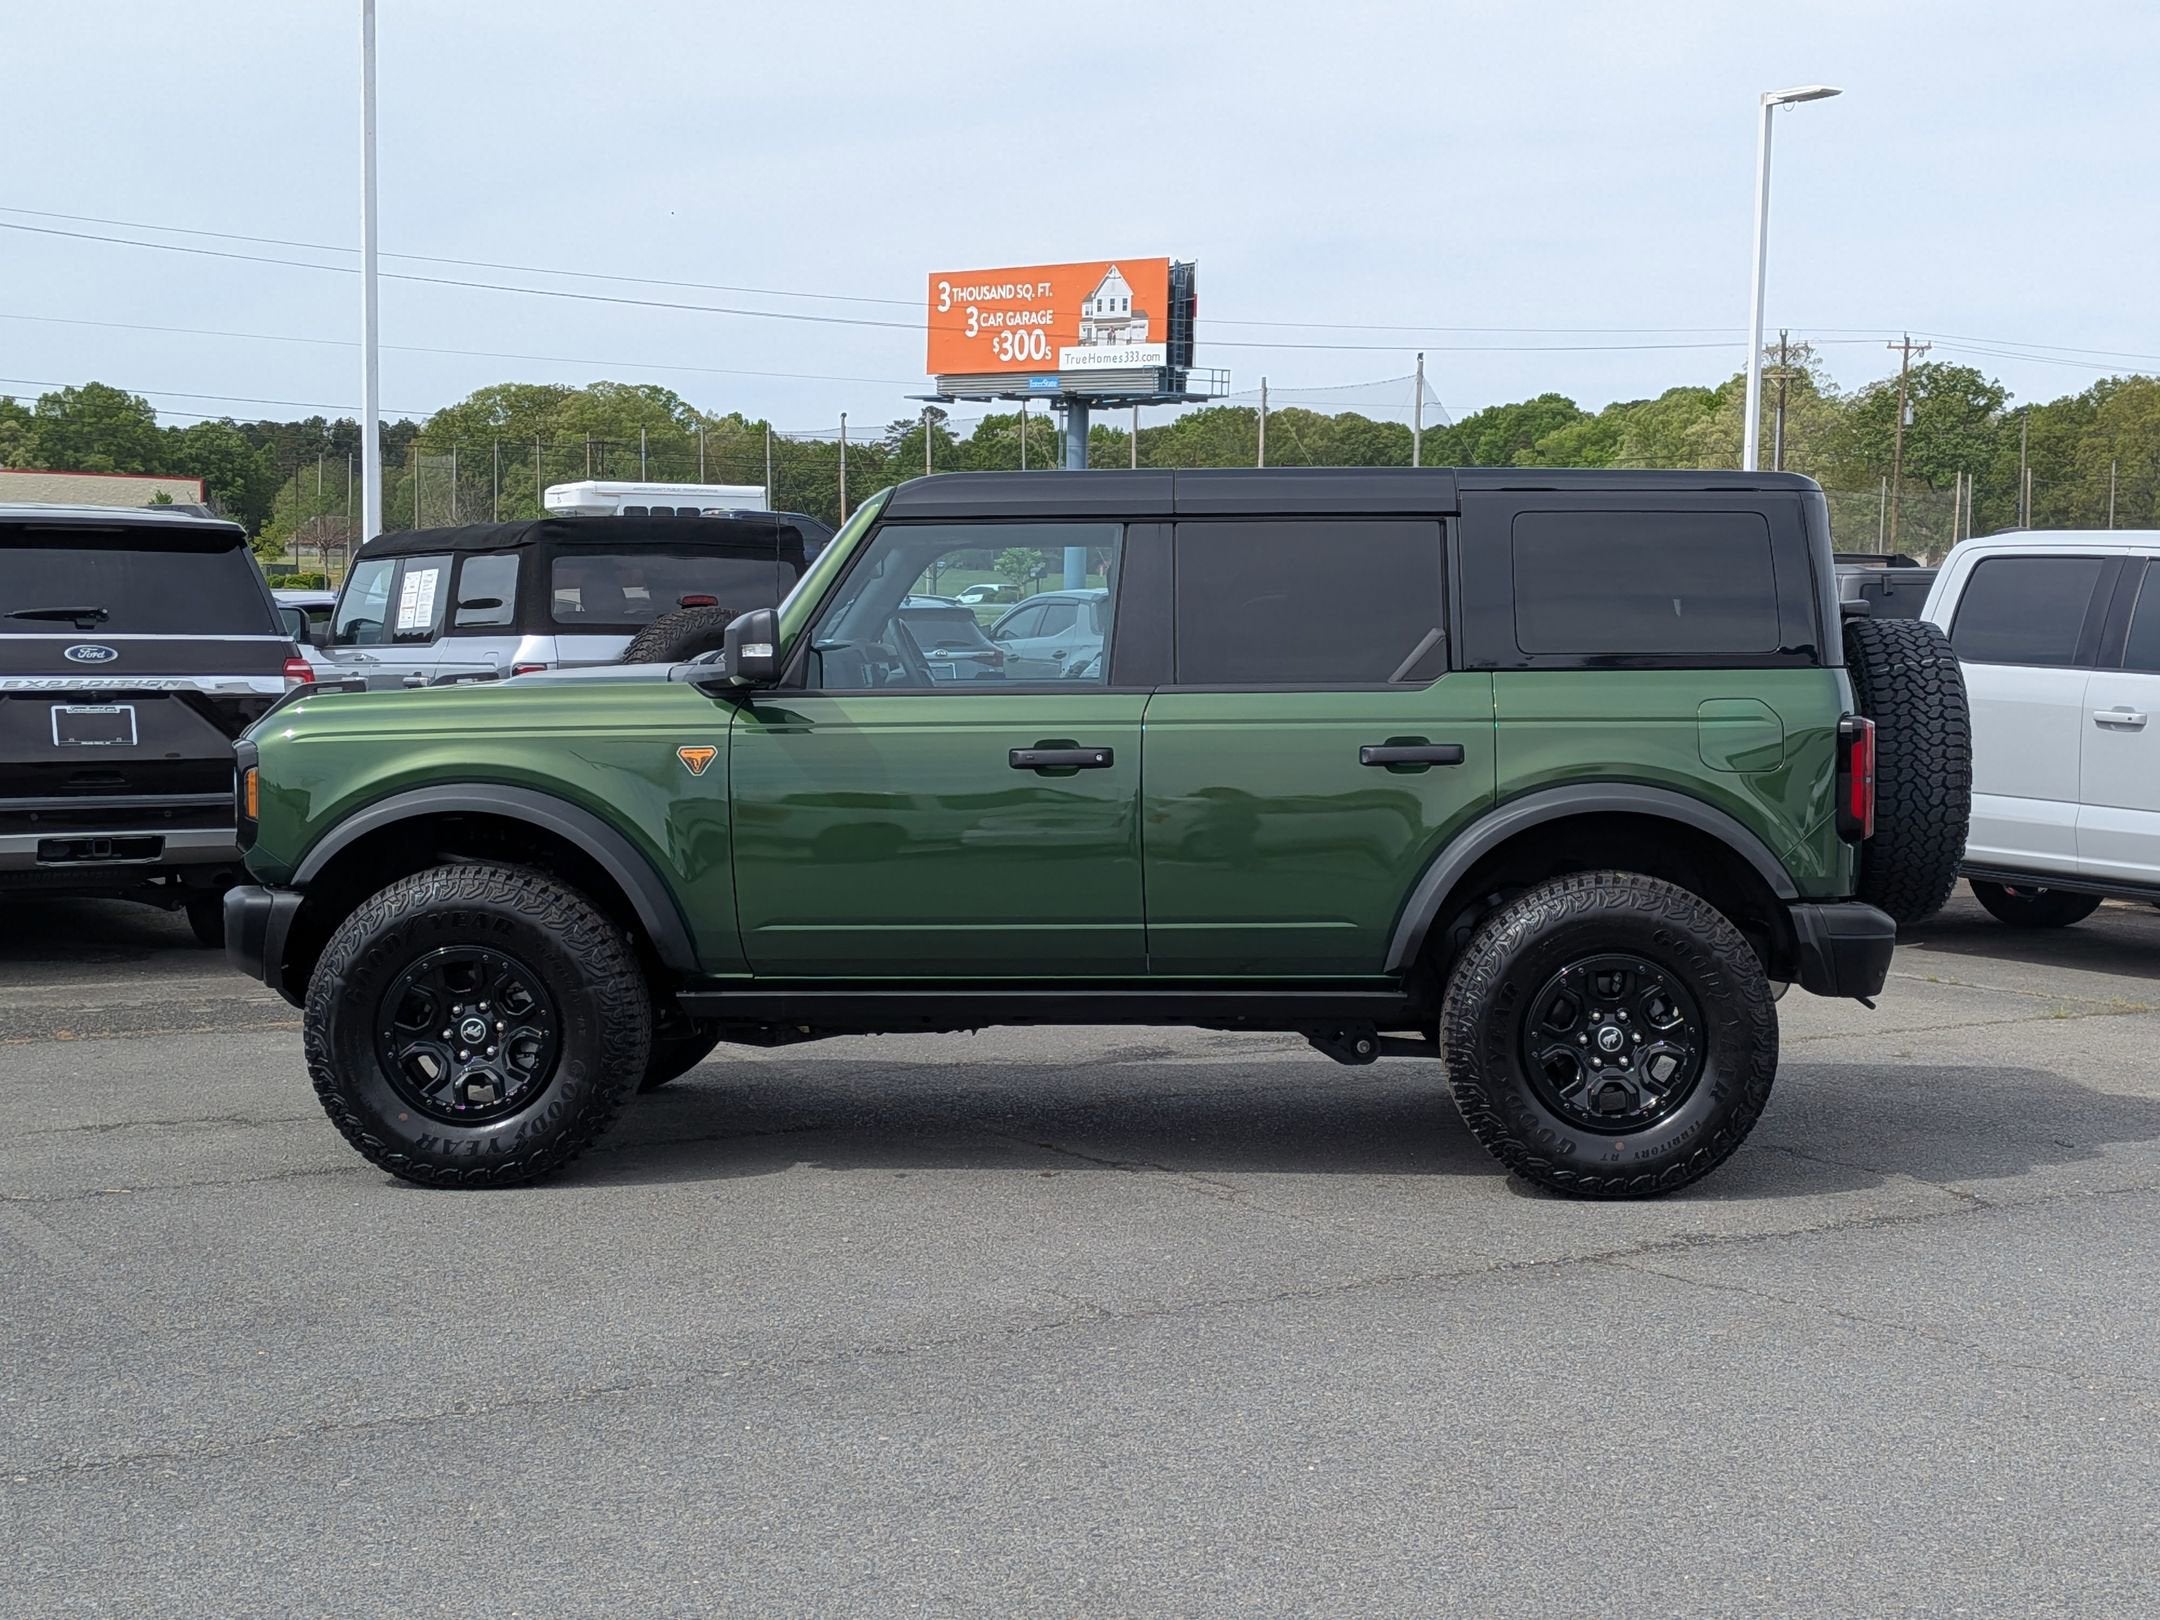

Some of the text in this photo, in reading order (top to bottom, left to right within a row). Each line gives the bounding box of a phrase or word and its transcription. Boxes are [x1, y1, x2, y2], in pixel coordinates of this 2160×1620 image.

[938, 281, 1053, 312] 3 THOUSAND SQ. FT.
[965, 306, 1054, 337] 3 CAR GARAGE
[1064, 350, 1161, 365] TrueHomes333.com
[77, 647, 105, 659] Ford
[2, 680, 180, 689] EXPEDITION
[1633, 1119, 1701, 1161] TERRITORY
